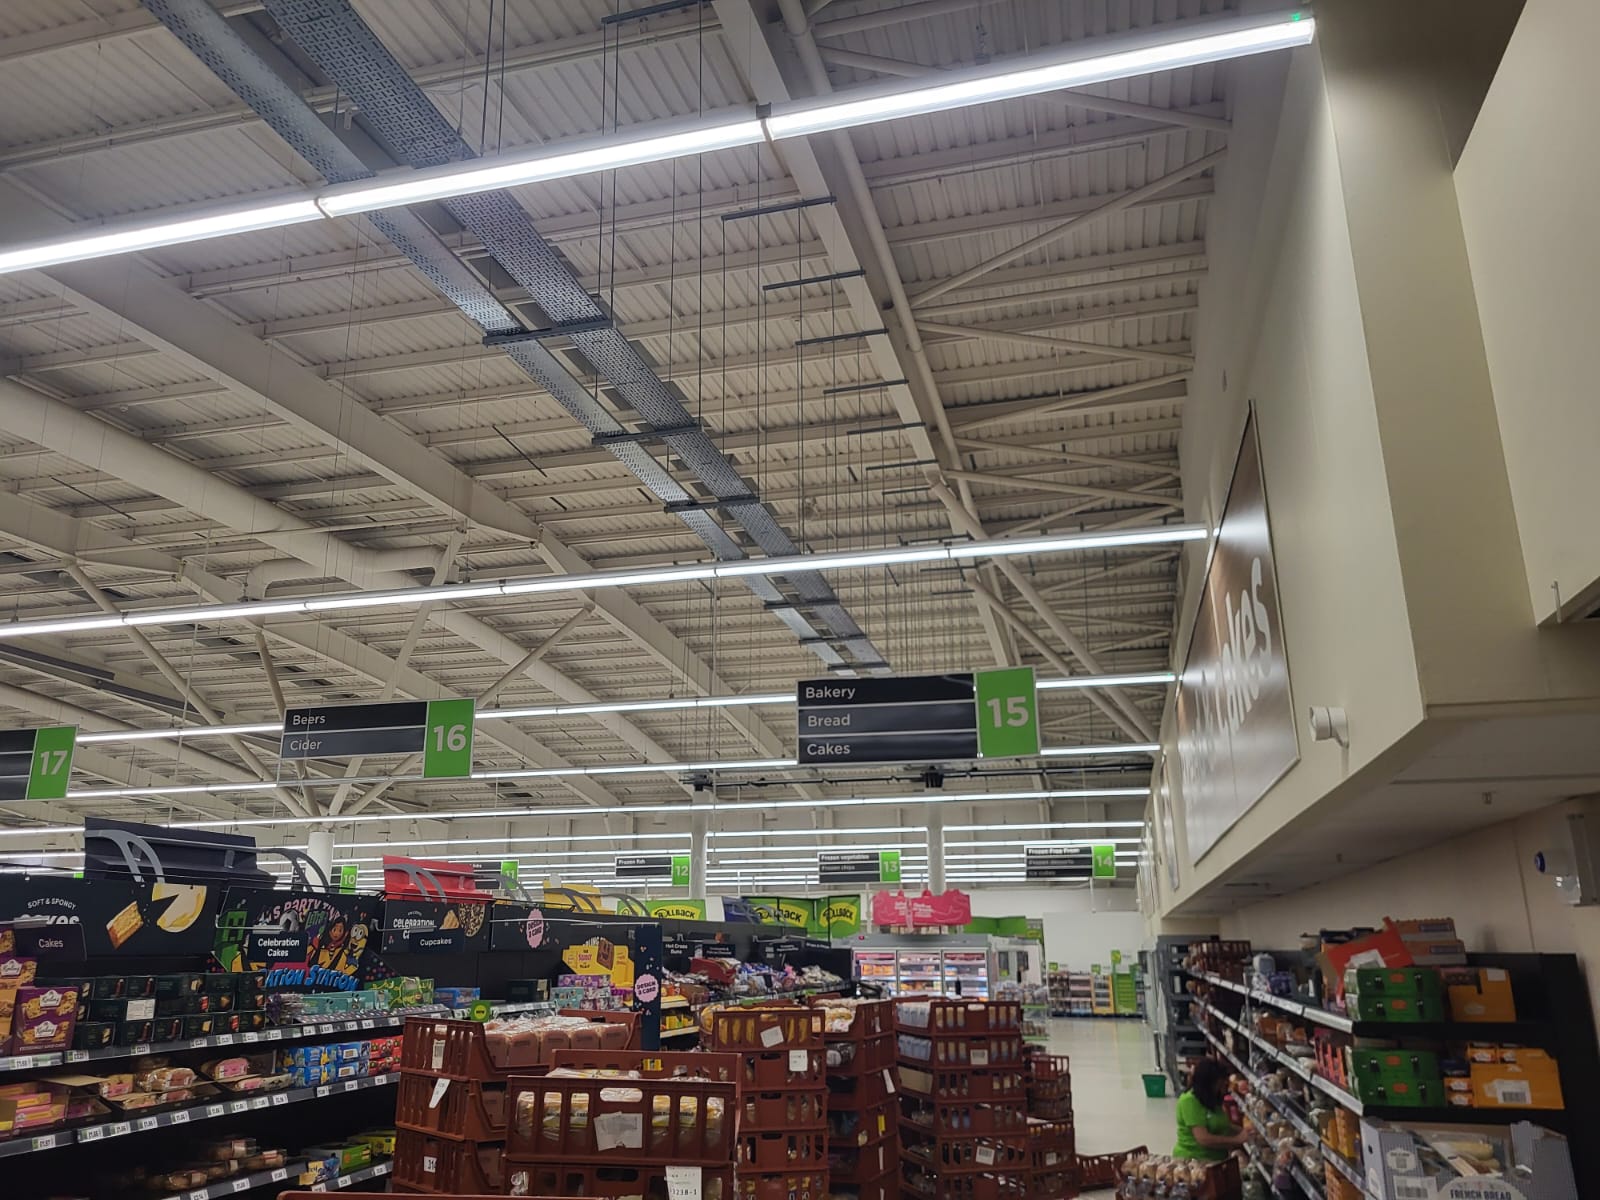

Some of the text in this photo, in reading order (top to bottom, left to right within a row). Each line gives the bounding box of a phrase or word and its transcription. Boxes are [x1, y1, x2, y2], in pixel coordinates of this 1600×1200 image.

[805, 686, 856, 700] Bakery
[986, 696, 1029, 728] 15
[292, 714, 326, 726] Beers
[808, 713, 850, 727] Bread
[433, 724, 466, 752] 16
[290, 740, 322, 751] Cider
[806, 743, 850, 756] Cakes
[40, 750, 68, 776] 17
[884, 861, 898, 872] 13
[1096, 855, 1112, 868] 14
[675, 865, 689, 876] 12
[343, 874, 356, 885] 10
[28, 898, 44, 908] SOFT
[52, 898, 76, 910] SPONGY
[38, 938, 64, 948] Cakes
[258, 938, 300, 947] Celebration
[420, 938, 452, 946] Cupcakes
[267, 949, 288, 957] Cakes
